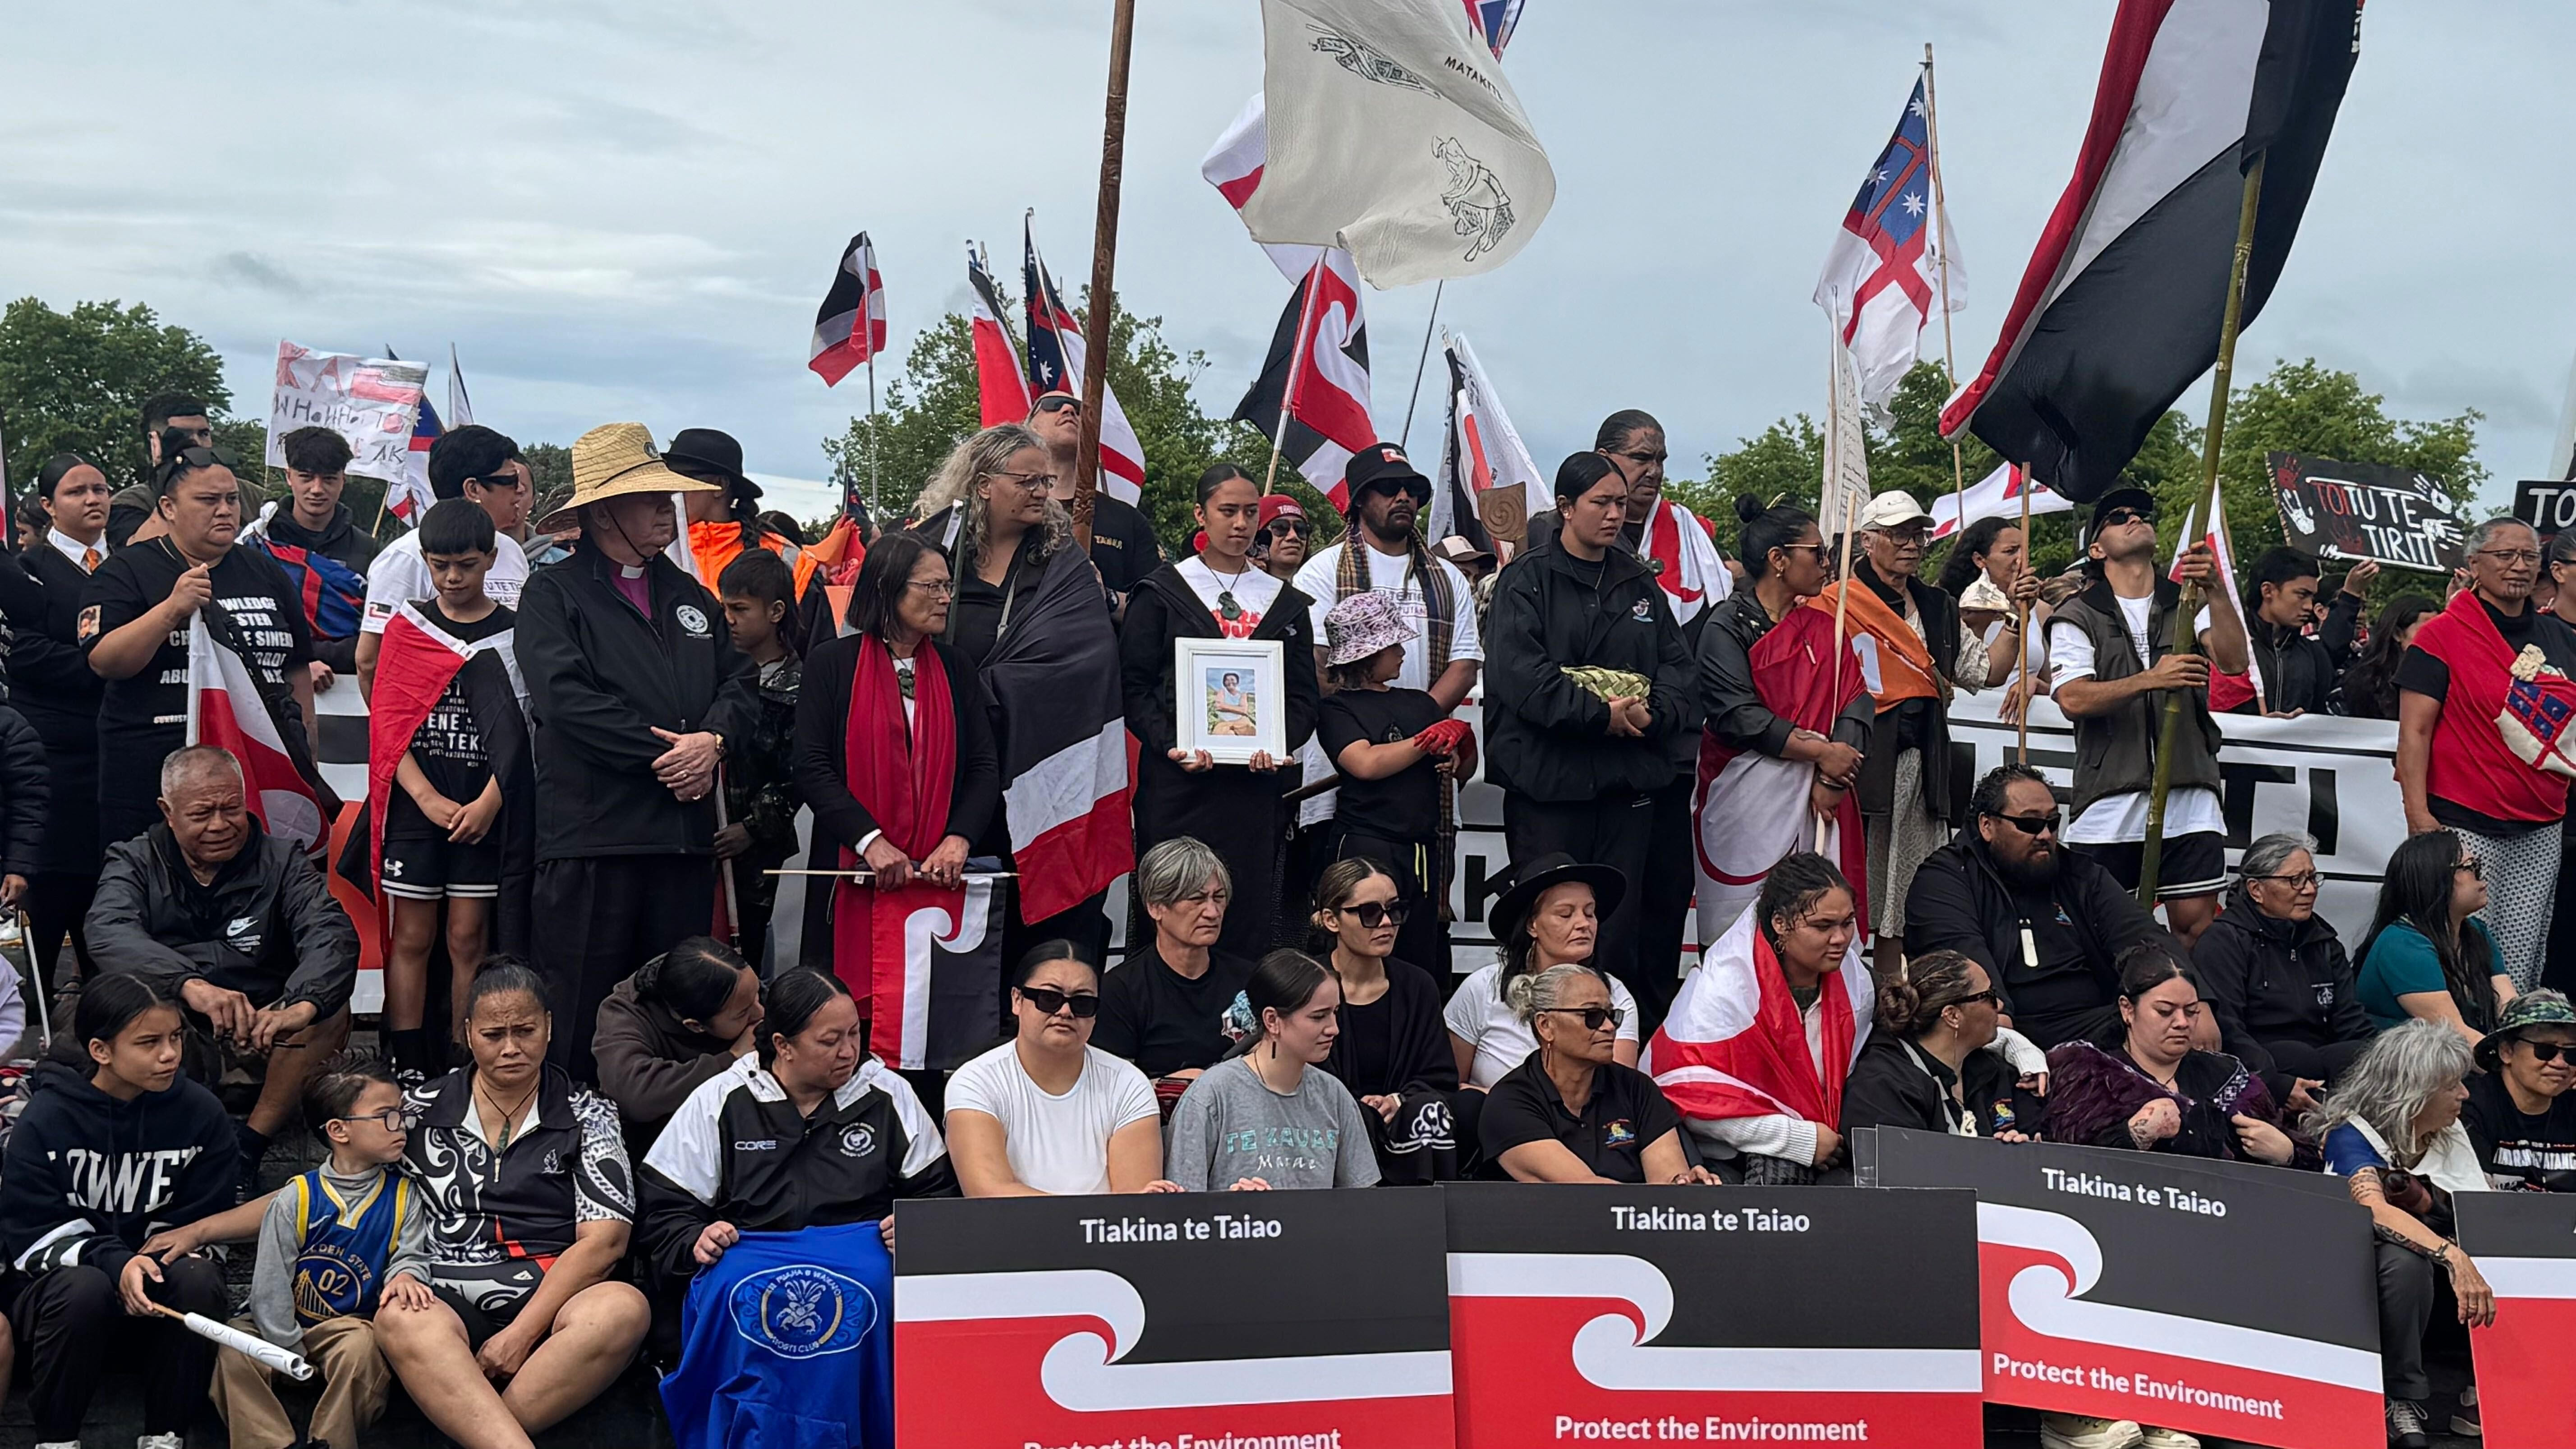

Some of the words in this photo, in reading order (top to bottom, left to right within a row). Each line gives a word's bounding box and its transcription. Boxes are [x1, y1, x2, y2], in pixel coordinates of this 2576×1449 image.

[2380, 491, 2421, 529] TE
[2360, 524, 2438, 566] TIRITI
[735, 1140, 777, 1150] CORE
[1226, 1129, 1257, 1153] TE
[2041, 1167, 2131, 1201] Tiakina
[2136, 1183, 2161, 1205] te
[2163, 1186, 2226, 1217] Taiao
[1079, 1217, 1178, 1243] Tiakina
[1183, 1218, 1210, 1240] te
[1214, 1214, 1282, 1239] Taiao
[1610, 1206, 1707, 1231] Tiakina
[1711, 1209, 1738, 1231] te
[1742, 1208, 1810, 1232] Taiao
[318, 1268, 350, 1296] 02
[1993, 1352, 2085, 1387] Protect
[2089, 1367, 2130, 1393] the
[2134, 1373, 2284, 1420] Environment
[1555, 1416, 1651, 1440] Protect
[1656, 1416, 1699, 1440] the
[1706, 1417, 1868, 1440] Environment
